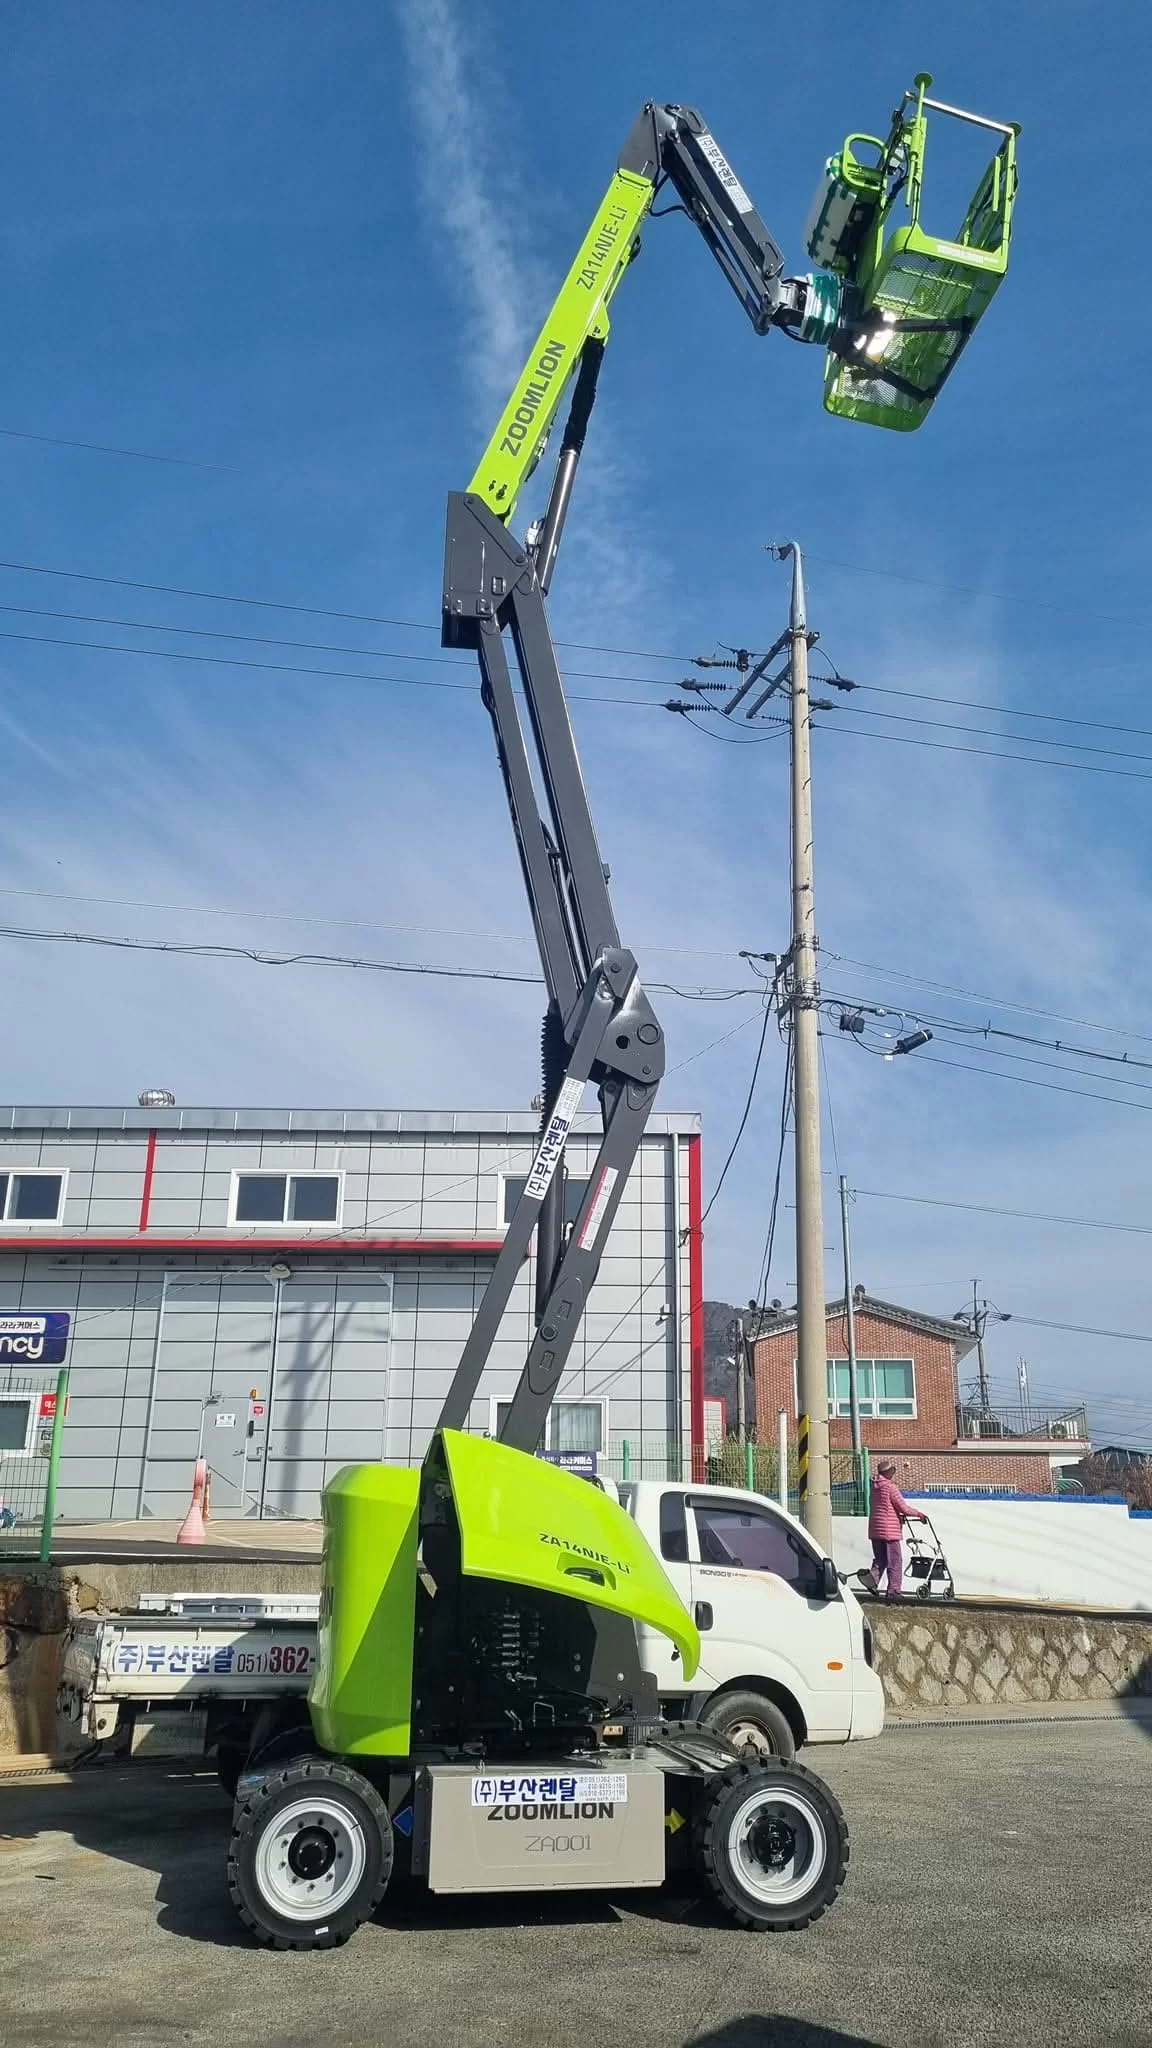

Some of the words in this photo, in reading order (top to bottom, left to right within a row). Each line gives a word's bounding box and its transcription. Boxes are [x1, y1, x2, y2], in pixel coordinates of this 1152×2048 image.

[576, 205, 629, 291] ZA14NJE-Li
[500, 339, 567, 458] ZOOMLION
[527, 1115, 570, 1197] (주)부산렌탈
[539, 1533, 630, 1575] ZA14NJE-Li
[112, 1644, 235, 1674] (주)부산렌탈
[474, 1778, 578, 1803] (주)부산렌탈
[487, 1802, 614, 1821] ZOOMLION
[525, 1835, 592, 1851] ZA001
